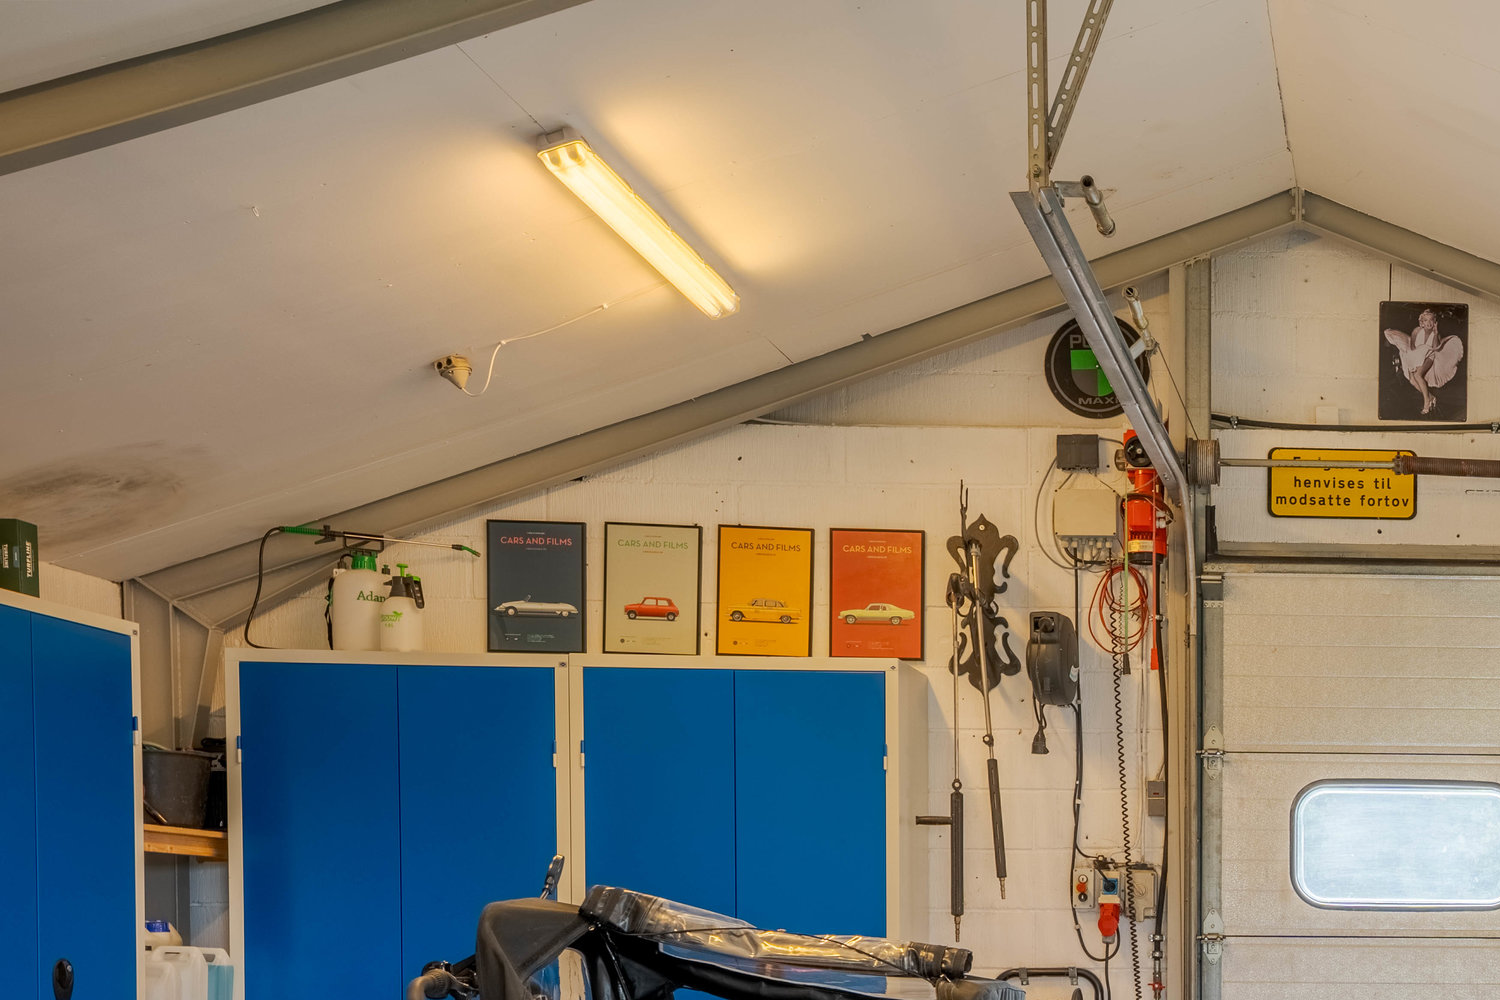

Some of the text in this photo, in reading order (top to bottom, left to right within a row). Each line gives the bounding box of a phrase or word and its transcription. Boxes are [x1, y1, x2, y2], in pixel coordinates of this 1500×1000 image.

[1293, 476, 1392, 490] henvises til
[1275, 494, 1409, 507] modsatte fortov
[500, 536, 573, 547] CARS AND FILMS
[617, 539, 689, 550] CARS AND FILMS
[730, 541, 801, 553] CARS AND FILMS
[842, 544, 913, 554] CARS AND FILMS
[25, 541, 33, 578] TURFLINE
